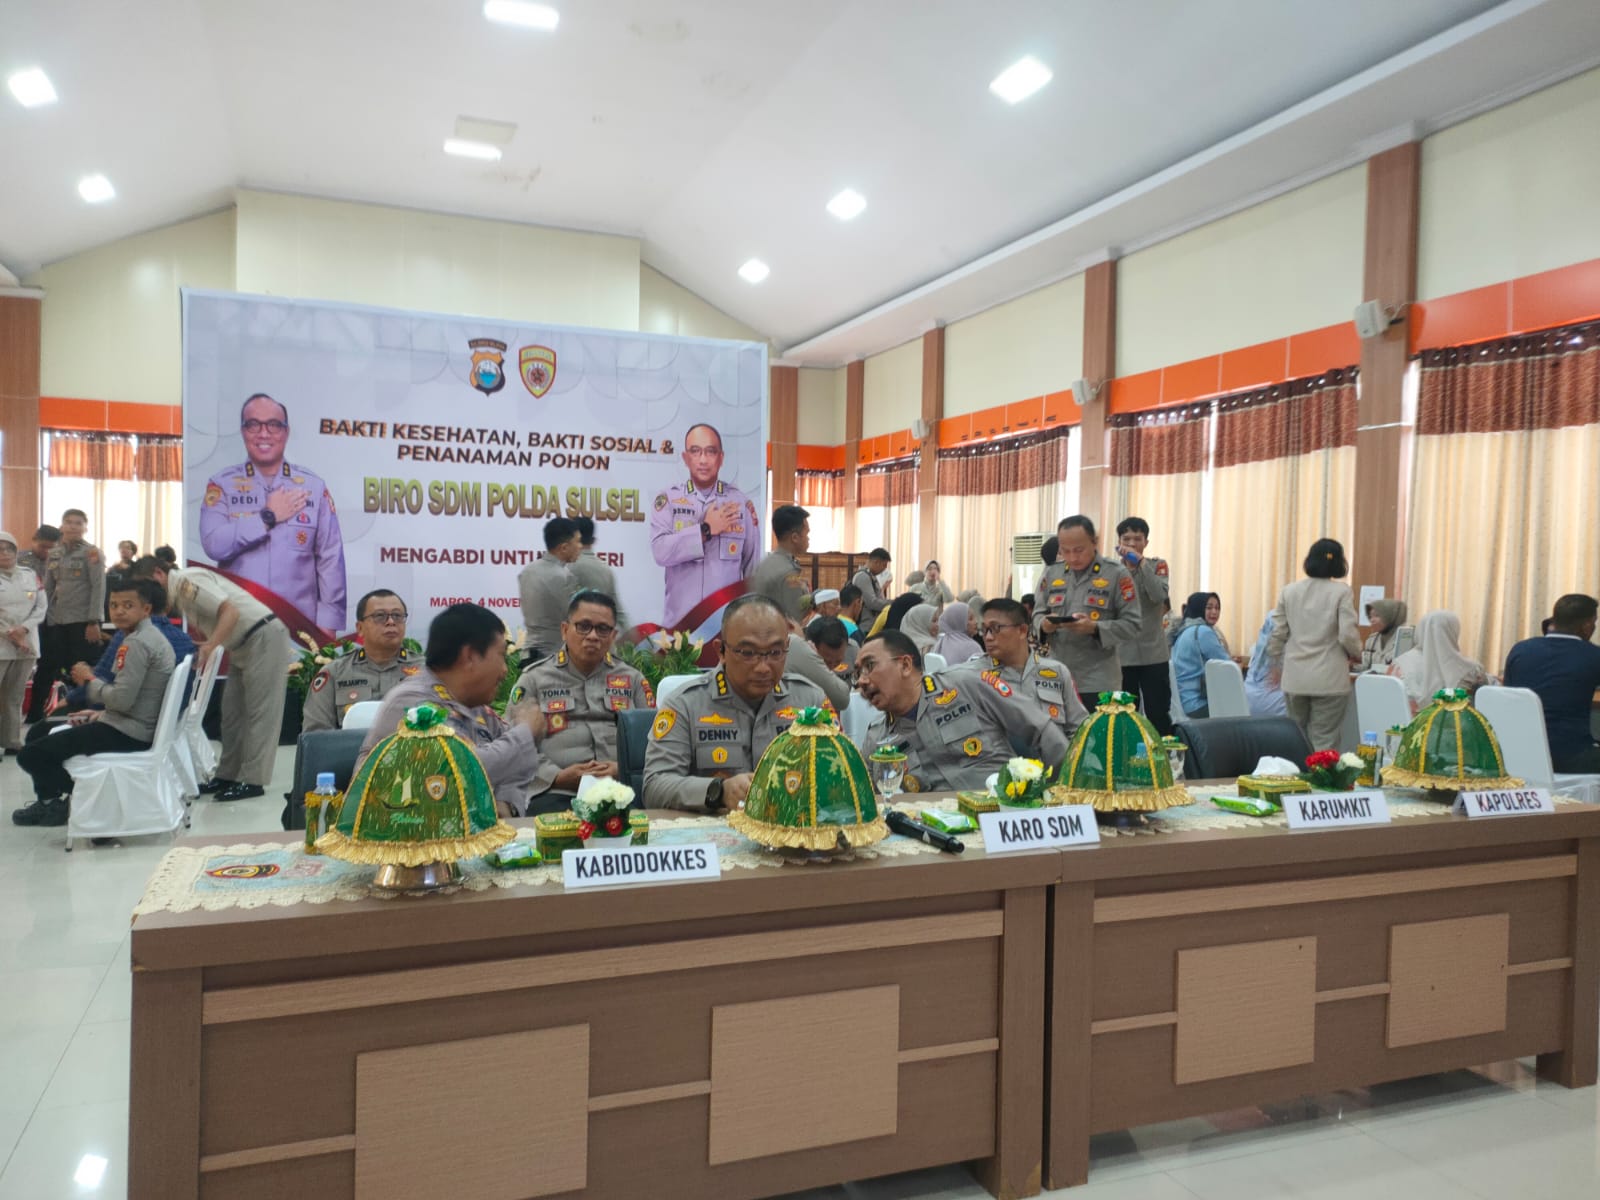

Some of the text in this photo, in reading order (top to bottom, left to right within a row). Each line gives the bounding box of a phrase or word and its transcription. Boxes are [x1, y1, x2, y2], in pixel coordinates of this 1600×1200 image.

[319, 418, 674, 454] BAKTI KESEHATAN, BAKTI SOSIAL &
[398, 444, 610, 470] PENANAMAN POHON
[231, 496, 258, 505] DEDI
[363, 476, 646, 522] BIRO SDM POLDA SULSEL
[380, 547, 485, 565] MENGABDI
[605, 688, 632, 697] POLRI
[1035, 680, 1063, 690] POLRI
[935, 703, 972, 726] POLRI
[698, 729, 739, 742] DENNY
[1298, 797, 1372, 821] KARUMKIT
[1475, 791, 1542, 812] KAPOLRES
[998, 814, 1084, 843] KARO SDM
[575, 849, 707, 879] KABIDDOKKES
